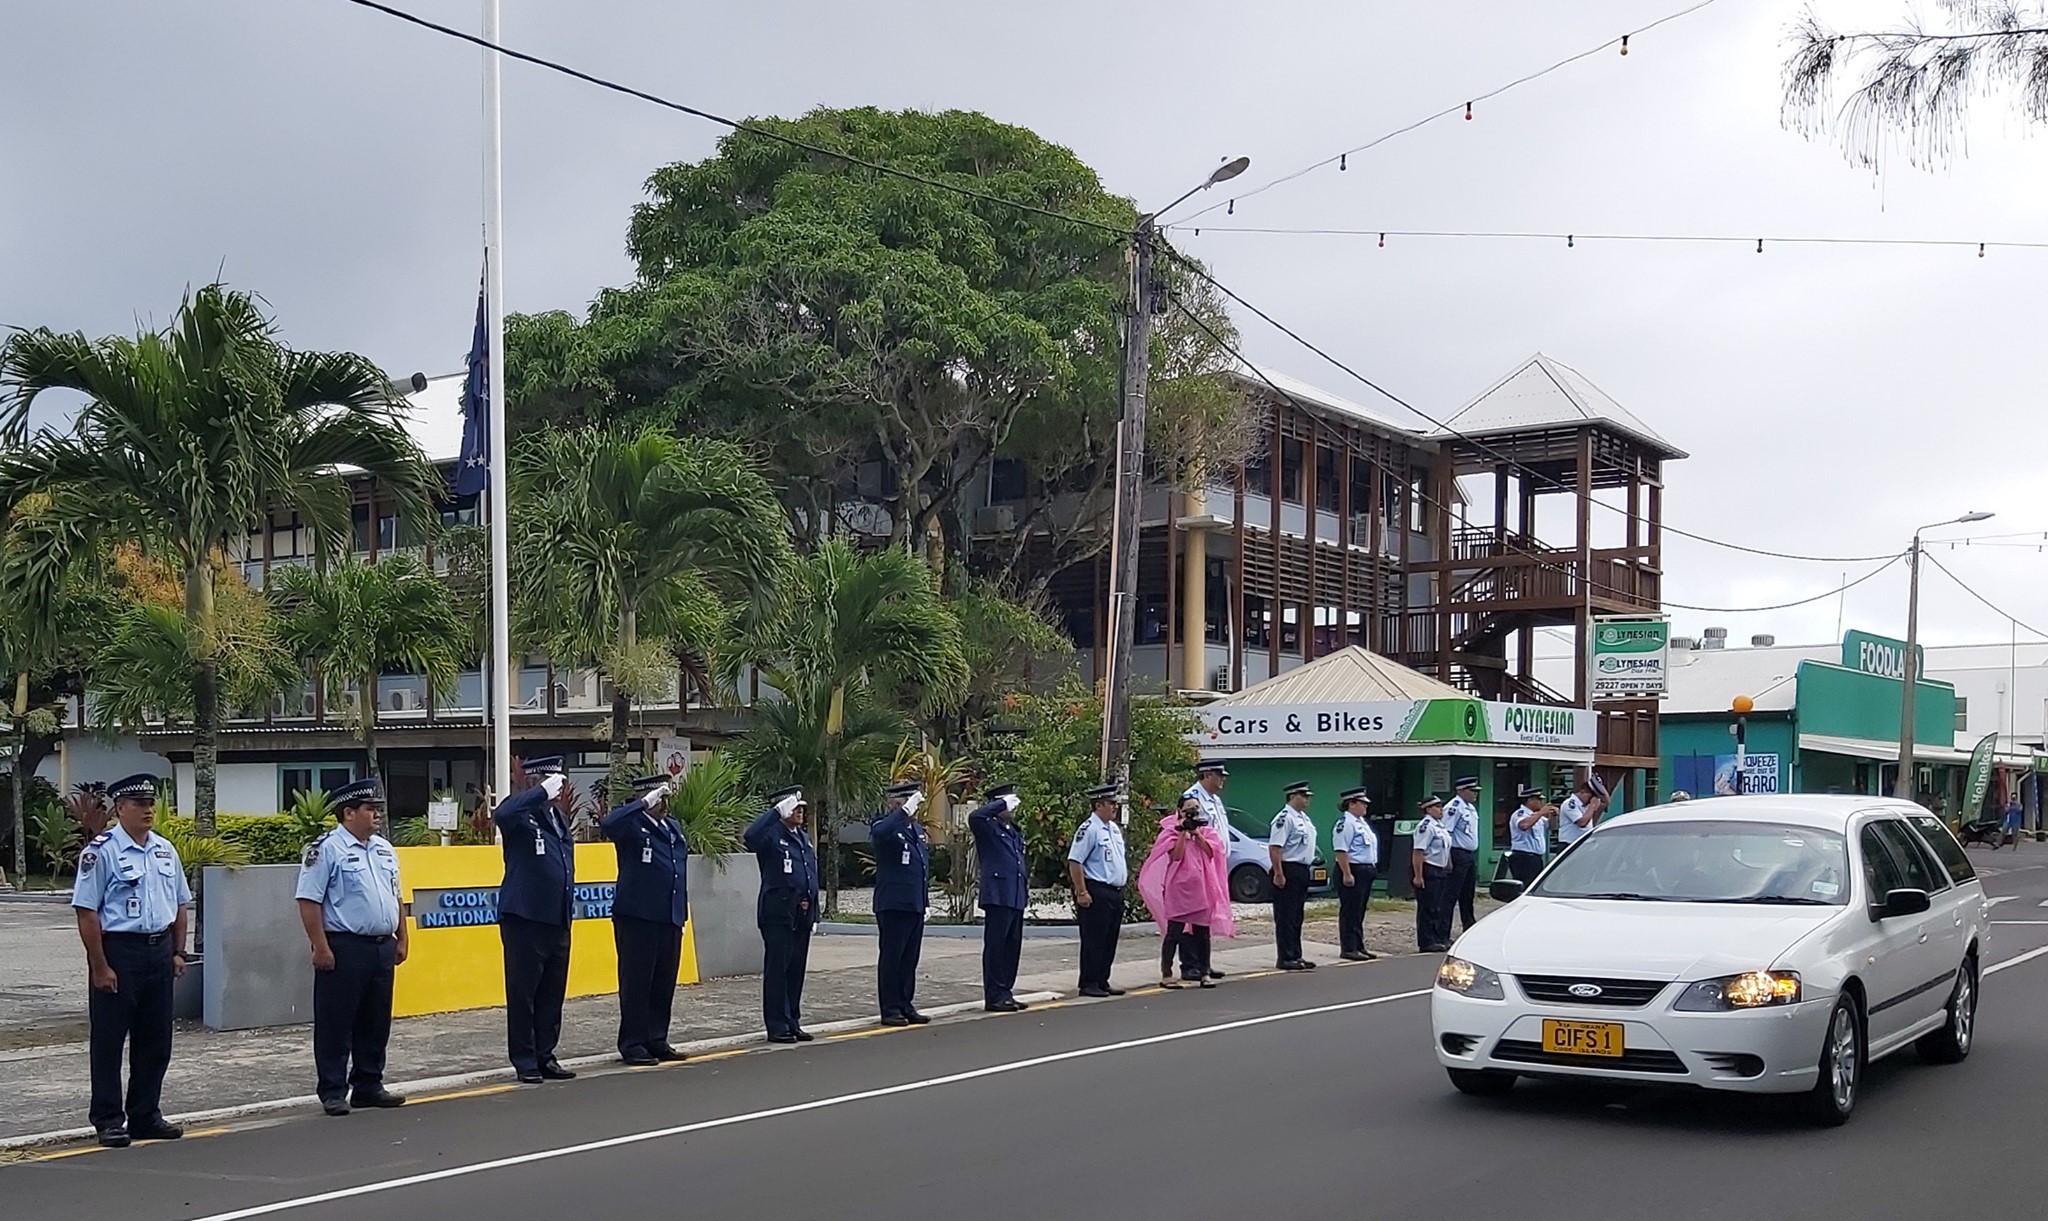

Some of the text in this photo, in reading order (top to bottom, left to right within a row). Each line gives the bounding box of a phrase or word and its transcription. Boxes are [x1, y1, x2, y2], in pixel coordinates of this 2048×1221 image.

[1860, 641, 1920, 680] FOODLA
[1218, 715, 1269, 734] Cars
[1285, 713, 1301, 732] &
[1317, 712, 1384, 732] Bikes
[1505, 707, 1574, 735] POLYNESIAN
[1971, 742, 1993, 804] Heineken
[1743, 775, 1777, 793] RARO
[442, 892, 488, 907] COOK
[573, 887, 614, 900] POLIC
[1554, 1028, 1598, 1048] CIFS
